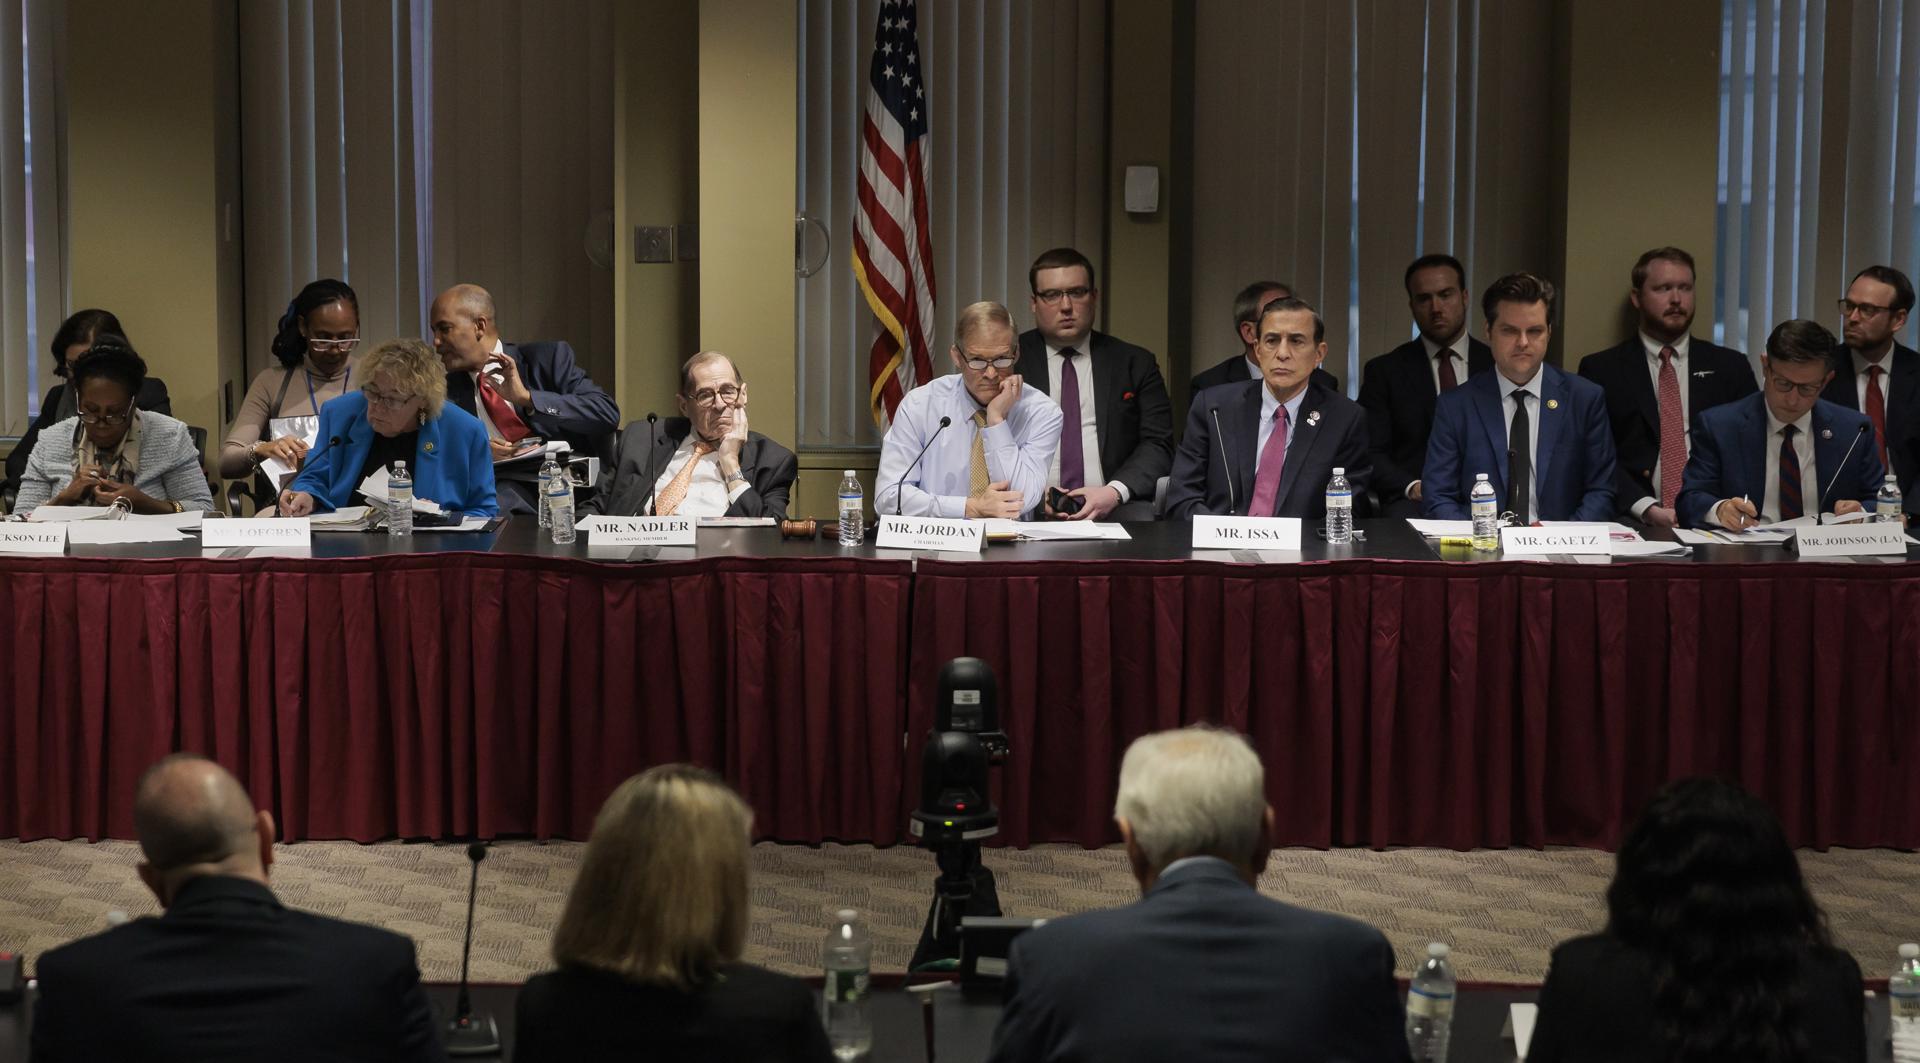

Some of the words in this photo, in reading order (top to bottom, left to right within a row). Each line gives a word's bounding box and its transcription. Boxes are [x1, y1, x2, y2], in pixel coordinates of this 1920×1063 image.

[239, 528, 302, 537] LOFGREN
[595, 523, 623, 533] MR.
[627, 521, 689, 533] NADLER
[886, 522, 912, 534] MR.
[916, 524, 977, 538] JORDAN
[38, 535, 60, 543] LEE
[1215, 527, 1243, 538] MR.
[1248, 528, 1280, 540] ISSA
[1514, 536, 1542, 546] MR.
[1546, 535, 1599, 545] GAETZ
[1801, 538, 1822, 546] MR.
[1825, 536, 1877, 546] JOHNSON
[1880, 535, 1903, 545] (LA)
